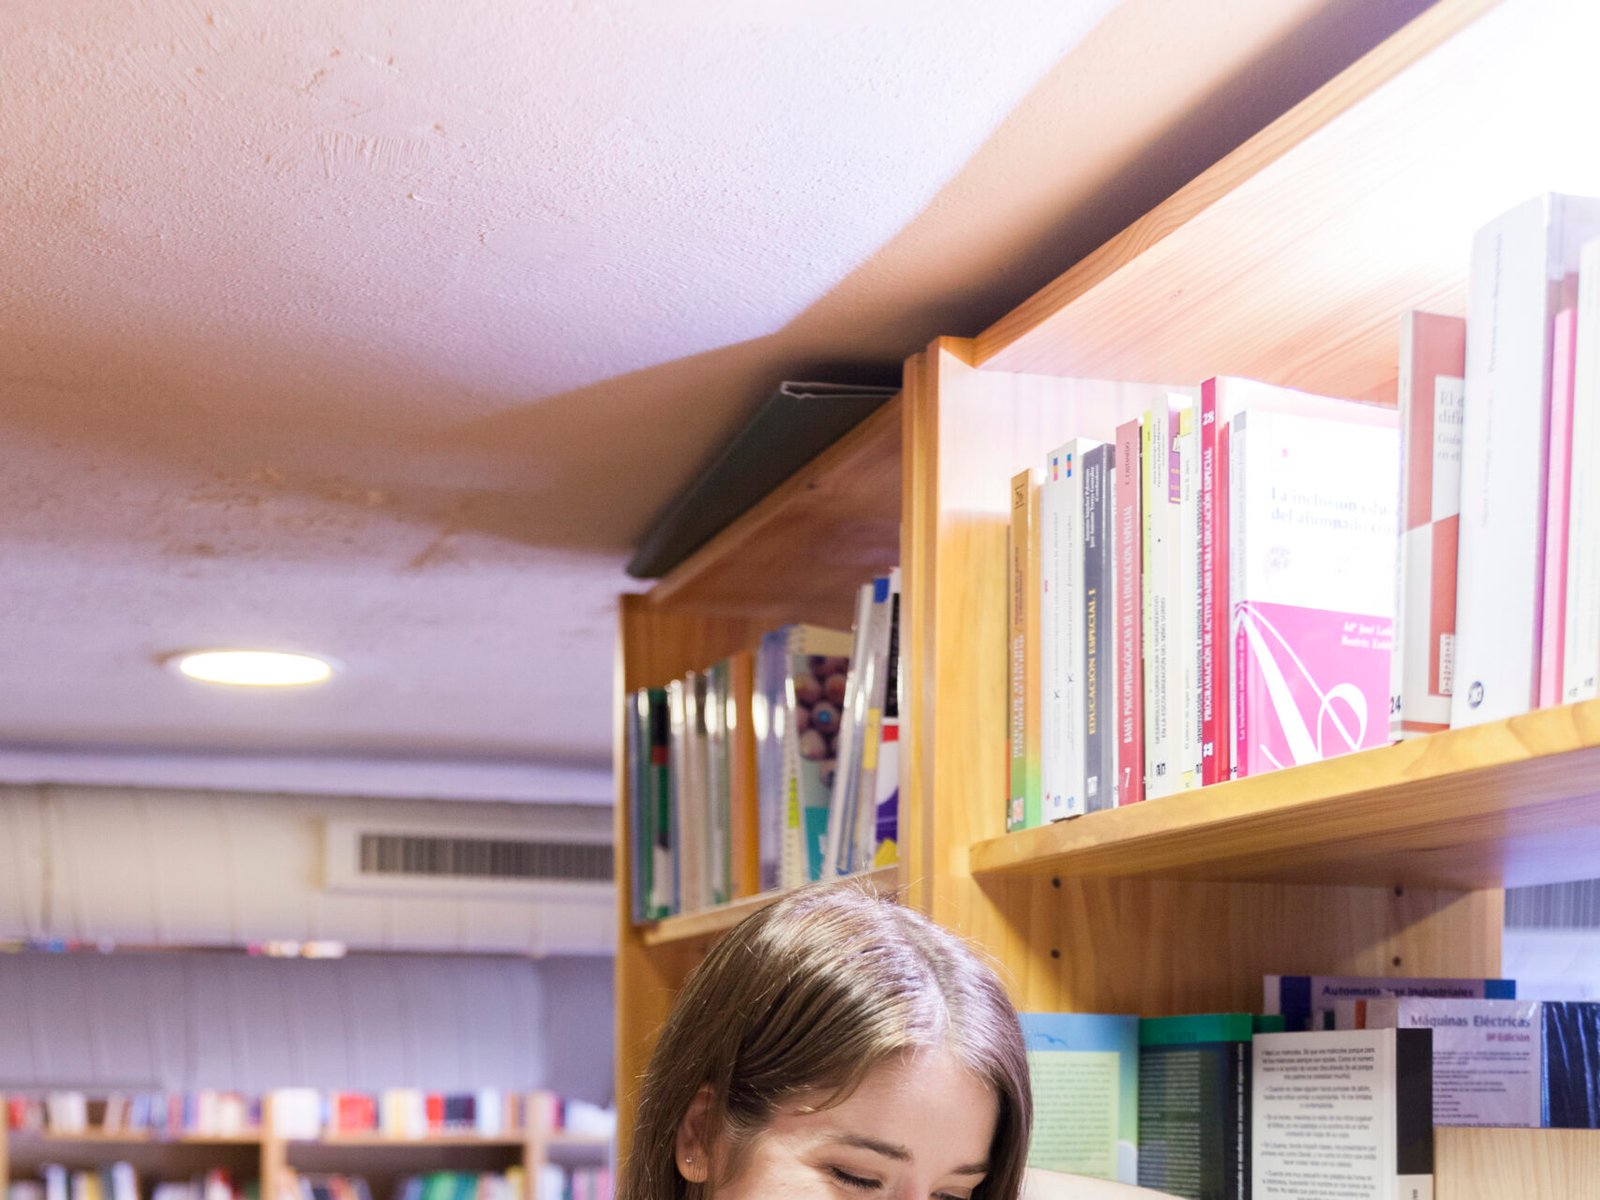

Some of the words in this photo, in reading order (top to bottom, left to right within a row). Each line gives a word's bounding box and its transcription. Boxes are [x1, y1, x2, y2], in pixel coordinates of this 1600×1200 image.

[1201, 410, 1215, 426] 28
[1203, 446, 1213, 490] ESPECIAL
[1123, 504, 1134, 544] ESPECIAL
[1202, 493, 1213, 545] EDUCACIÓN
[1122, 546, 1133, 598] EDUCACIÓN
[1202, 547, 1213, 570] PARA
[1122, 613, 1133, 626] DE
[1202, 572, 1213, 632] ACTIVIDADES
[1087, 600, 1097, 654] ESPECIAL
[1086, 657, 1097, 735] EDUCACIÓN
[1122, 629, 1133, 715] PSICOPEDAGÓGICAS
[1202, 647, 1213, 721] PROGRAMACIÓN
[1123, 717, 1133, 743] BASES
[1410, 1013, 1468, 1029] Máquinas
[1473, 1014, 1532, 1028] Eléctricas
